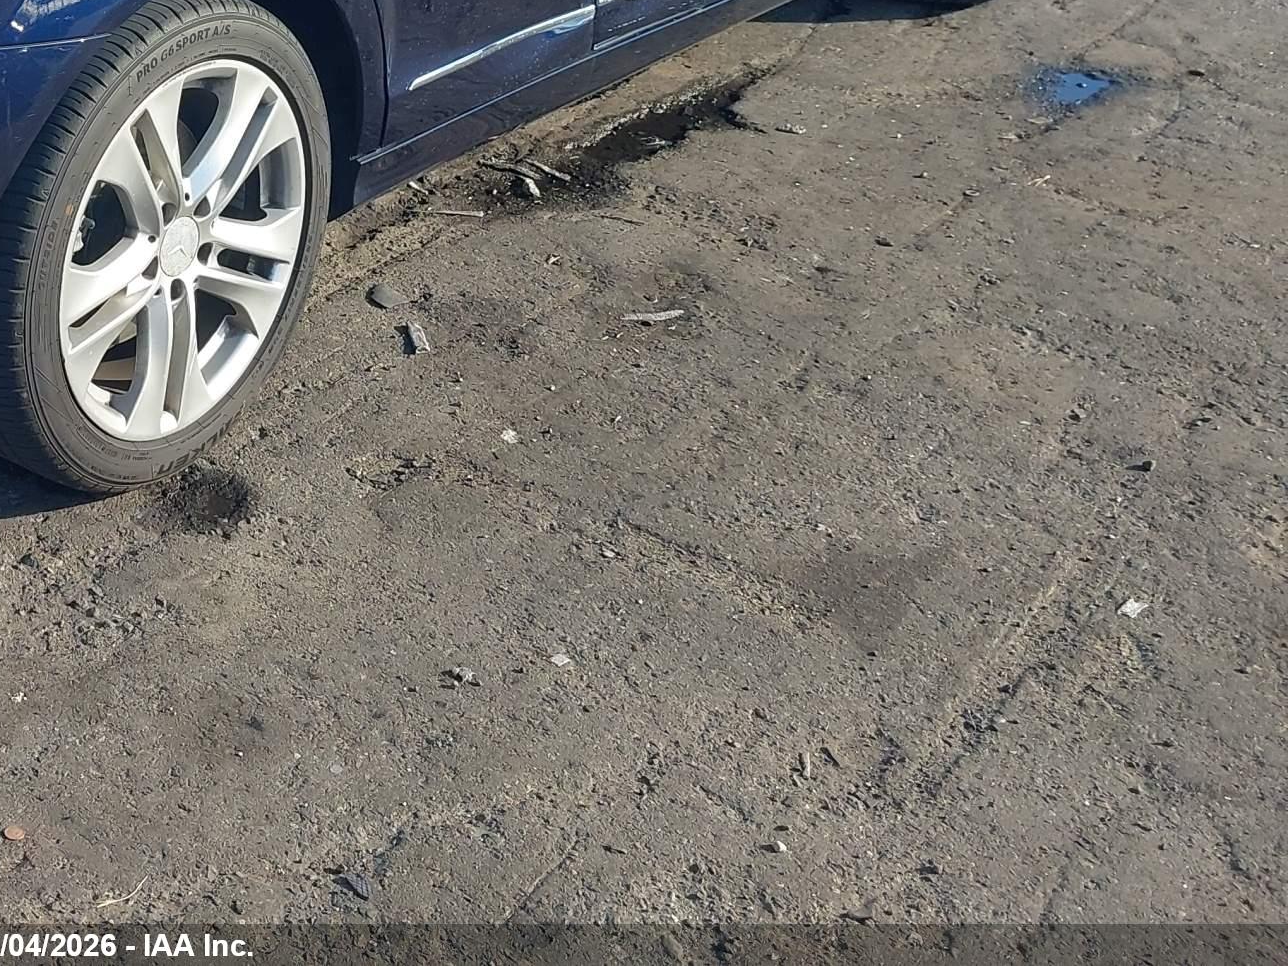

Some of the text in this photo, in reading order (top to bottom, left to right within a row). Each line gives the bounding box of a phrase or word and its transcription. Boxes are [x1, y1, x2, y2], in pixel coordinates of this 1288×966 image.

[136, 57, 158, 82] PRO
[176, 27, 210, 51] SPORT
[212, 24, 231, 37] A/S
